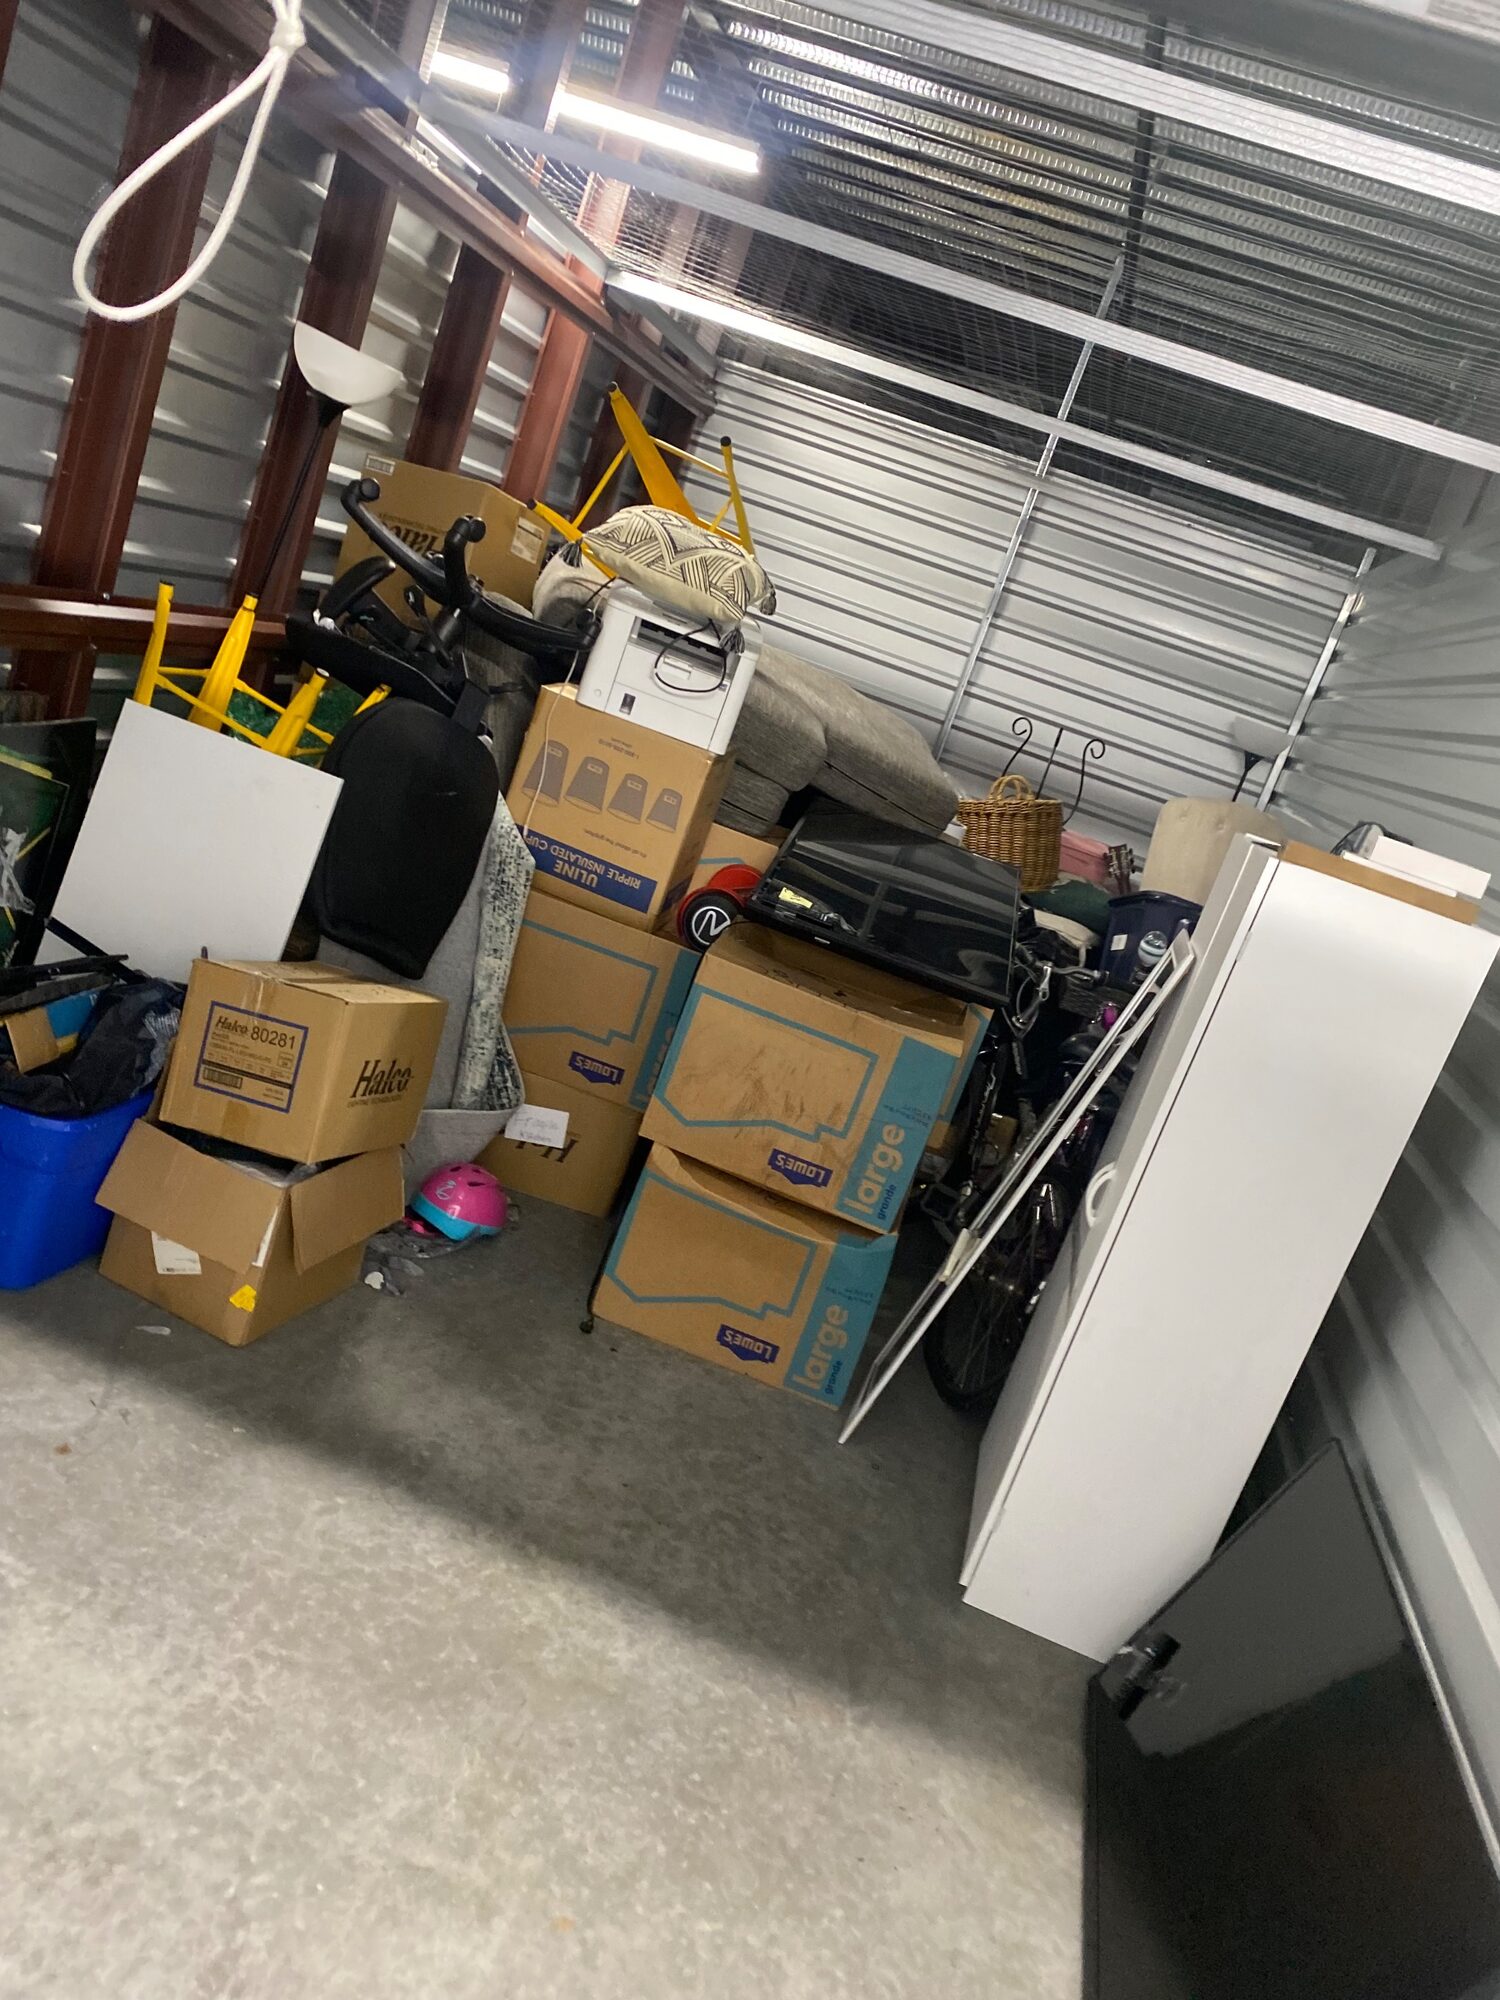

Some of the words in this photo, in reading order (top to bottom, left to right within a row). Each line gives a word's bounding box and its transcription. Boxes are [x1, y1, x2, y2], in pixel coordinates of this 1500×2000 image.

[550, 845, 605, 875] INSULATED
[554, 859, 599, 888] ULINE
[606, 868, 642, 890] RIPPLE
[250, 1025, 295, 1050] 80281
[349, 1059, 412, 1098] Halco
[775, 1153, 826, 1183] LOWE'S
[842, 1123, 906, 1215] large
[876, 1183, 897, 1221] grande
[723, 1329, 774, 1360] LOWE'S
[792, 1303, 849, 1390] large
[823, 1359, 844, 1395] grande
